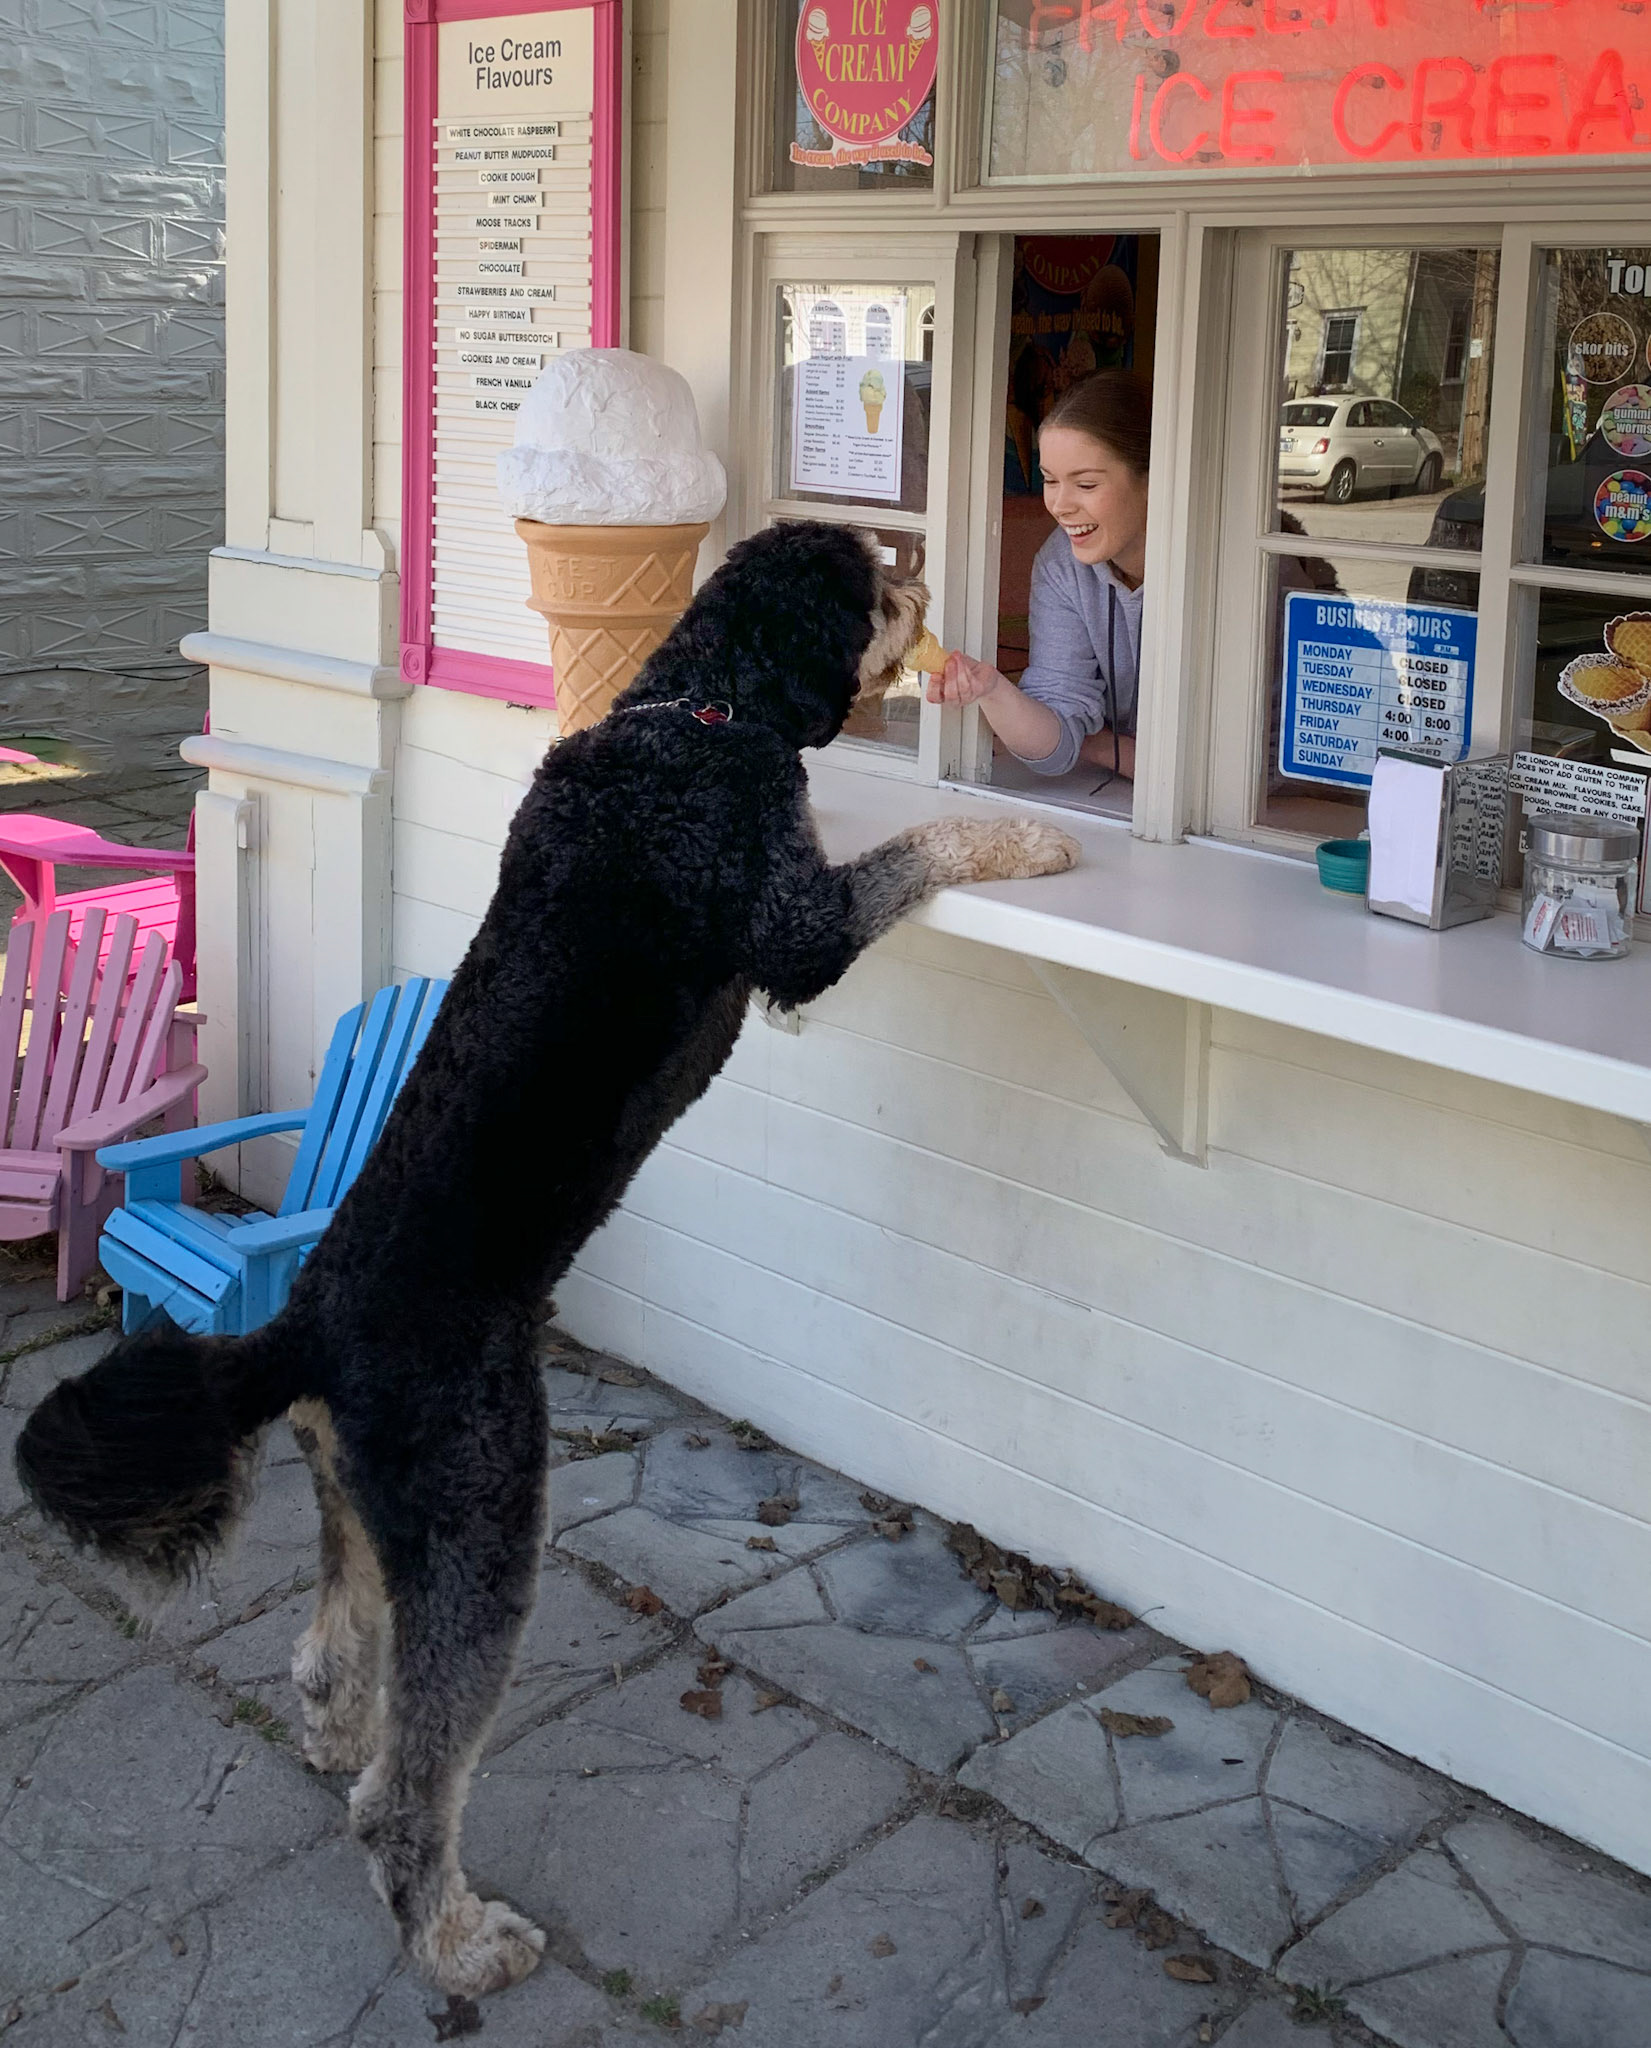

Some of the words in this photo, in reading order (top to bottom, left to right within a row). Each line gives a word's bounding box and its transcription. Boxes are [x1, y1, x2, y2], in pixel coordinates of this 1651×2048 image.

[851, 0, 888, 36] ICE
[469, 42, 495, 64] Ice
[501, 38, 562, 61] Cream
[825, 44, 906, 82] CREAM
[476, 66, 553, 90] Flavours
[812, 88, 913, 136] COMPANY
[1130, 71, 1284, 163] ICE
[450, 128, 471, 138] WHITE
[473, 127, 515, 137] CHOCOLATE
[517, 125, 556, 136] RASPBERRY
[455, 151, 481, 161] PEANUT
[484, 150, 509, 160] BUTTER
[512, 149, 552, 160] MUDPUDDLE
[481, 173, 508, 182] COOKIE
[511, 171, 536, 181] DOUGH
[492, 195, 510, 205] MINT
[513, 194, 537, 204] CHUNK
[476, 218, 501, 227] MOOSE
[504, 217, 531, 227] TRACKS
[479, 241, 519, 250] SPIDERMAN
[478, 263, 521, 273] CHOCOLATE
[457, 287, 507, 297] STRAWBERRIES
[510, 288, 525, 297] AND
[527, 288, 553, 298] CREAM
[468, 310, 490, 319] HAPPY
[493, 310, 526, 320] BIRTHDAY
[459, 331, 471, 340] NO
[473, 332, 496, 341] SUGAR
[498, 333, 553, 343] BUTTERSCOTCH
[1575, 341, 1603, 355] skor
[1605, 342, 1629, 356] bits
[461, 354, 493, 364] COOKIES
[495, 355, 510, 364] AND
[512, 356, 537, 366] CREAM
[476, 377, 502, 387] FRENCH
[505, 378, 532, 388] VANILLA
[475, 400, 498, 410] BLACK
[1610, 492, 1648, 505] peanut
[1605, 505, 1650, 521] m&m's
[1303, 644, 1353, 661] MONDAY
[1303, 661, 1354, 678] TUESDAY
[1399, 657, 1448, 675] CLOSED
[1302, 679, 1373, 700] WEDNESDAY
[1399, 675, 1447, 692] CLOSED
[1301, 697, 1362, 716] THURSDAY
[1398, 692, 1446, 711] CLOSED
[1299, 714, 1339, 731] FRIDAY
[1385, 712, 1412, 725] 4:00
[1425, 717, 1451, 731] 8:00
[1299, 732, 1359, 752] SATURDAY
[1382, 728, 1409, 742] 4:00
[1298, 749, 1344, 767] SUNDAY
[1515, 754, 1527, 762] THE
[1530, 757, 1560, 768] LONDON
[1562, 763, 1574, 771] ICE
[1578, 766, 1604, 776] CREAM
[1607, 772, 1645, 784] COMPANY
[1517, 763, 1536, 771] DOES
[1539, 766, 1554, 774] NOT
[1557, 770, 1572, 779] ADD
[1575, 774, 1602, 785] GLUTEN
[1605, 779, 1615, 787] TO
[1619, 782, 1639, 792] THEIR
[1510, 773, 1521, 781] ICE
[1525, 776, 1549, 786] CREAM
[1574, 786, 1611, 798] FLAVOURS
[1615, 793, 1634, 803] THAT
[1509, 782, 1541, 793] CONTAIN
[1544, 788, 1579, 801] BROWNIE,
[1582, 796, 1618, 809] COOKIES,
[1621, 803, 1644, 814] CAKE,
[1524, 796, 1552, 807] DOUGH,
[1555, 802, 1577, 812] CREPE
[1580, 807, 1591, 815] OR
[1594, 809, 1609, 819] ANY
[1611, 813, 1636, 823] OTHER
